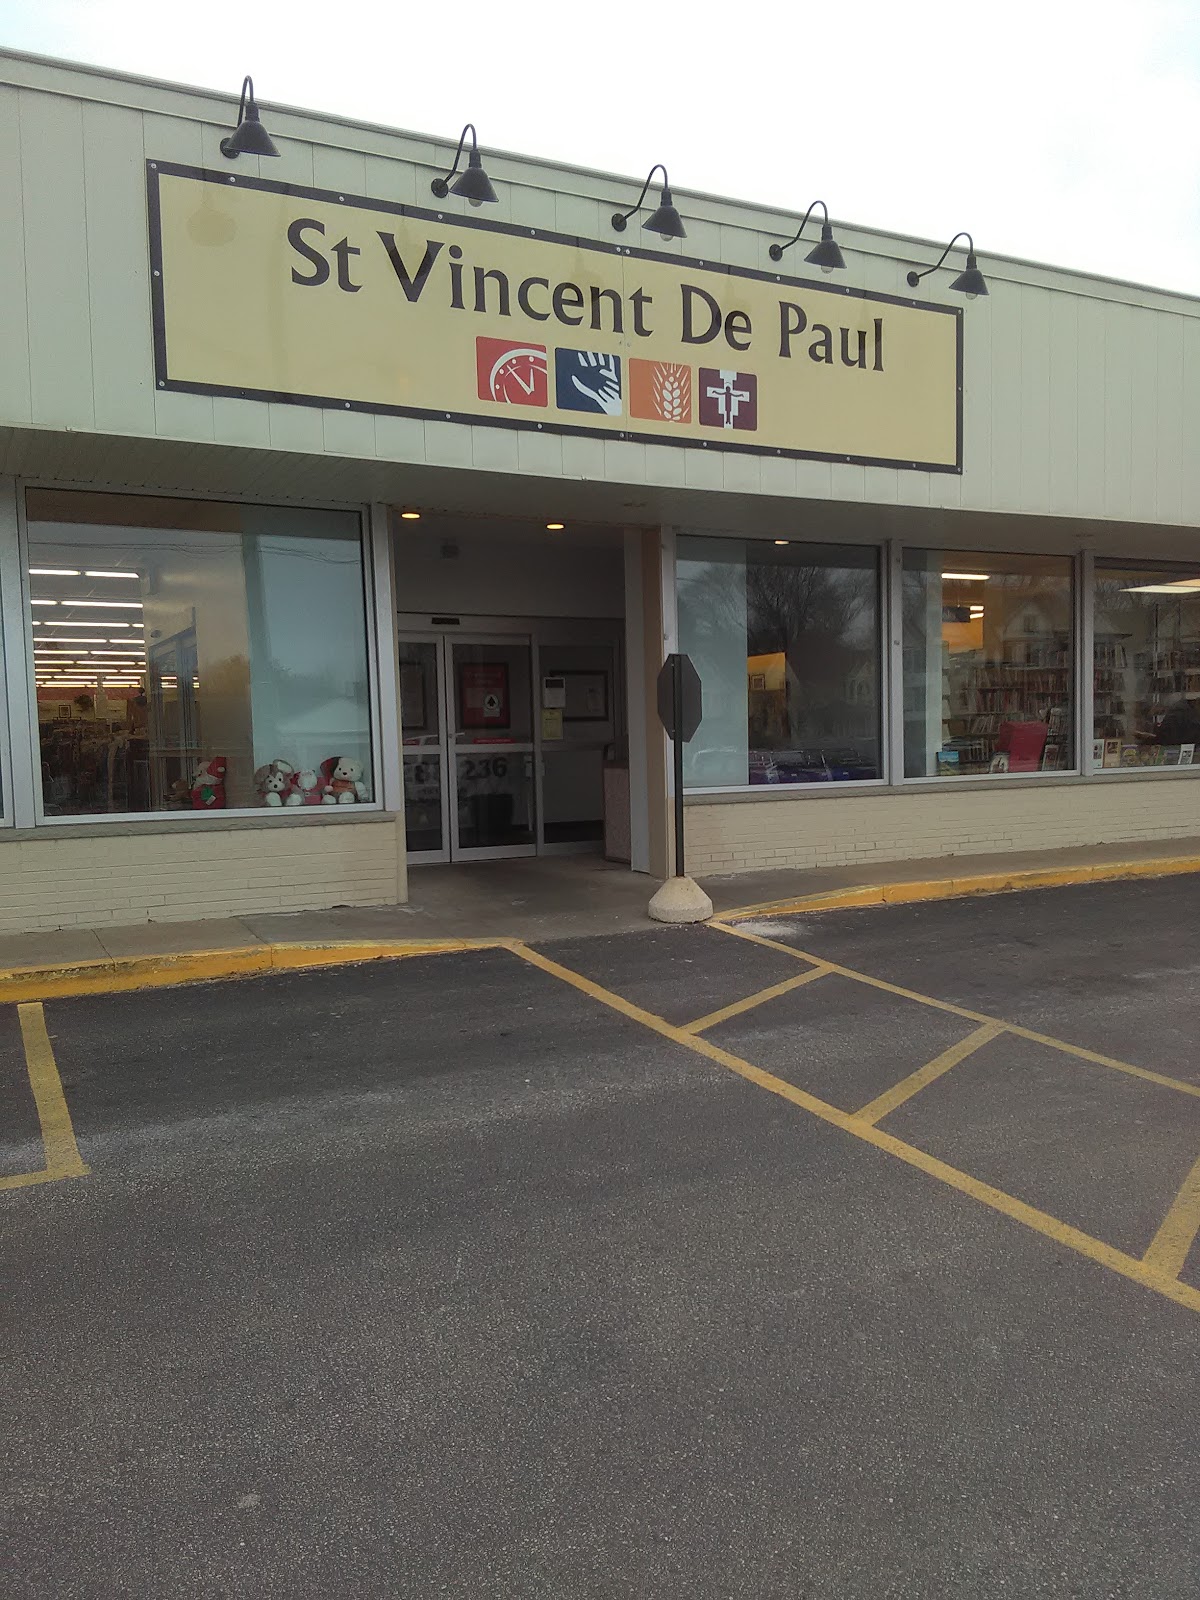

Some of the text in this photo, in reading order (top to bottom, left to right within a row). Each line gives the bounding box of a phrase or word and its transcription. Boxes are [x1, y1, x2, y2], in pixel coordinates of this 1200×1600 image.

[287, 218, 884, 372] St Vincent De Paul
[465, 758, 508, 779] 236
